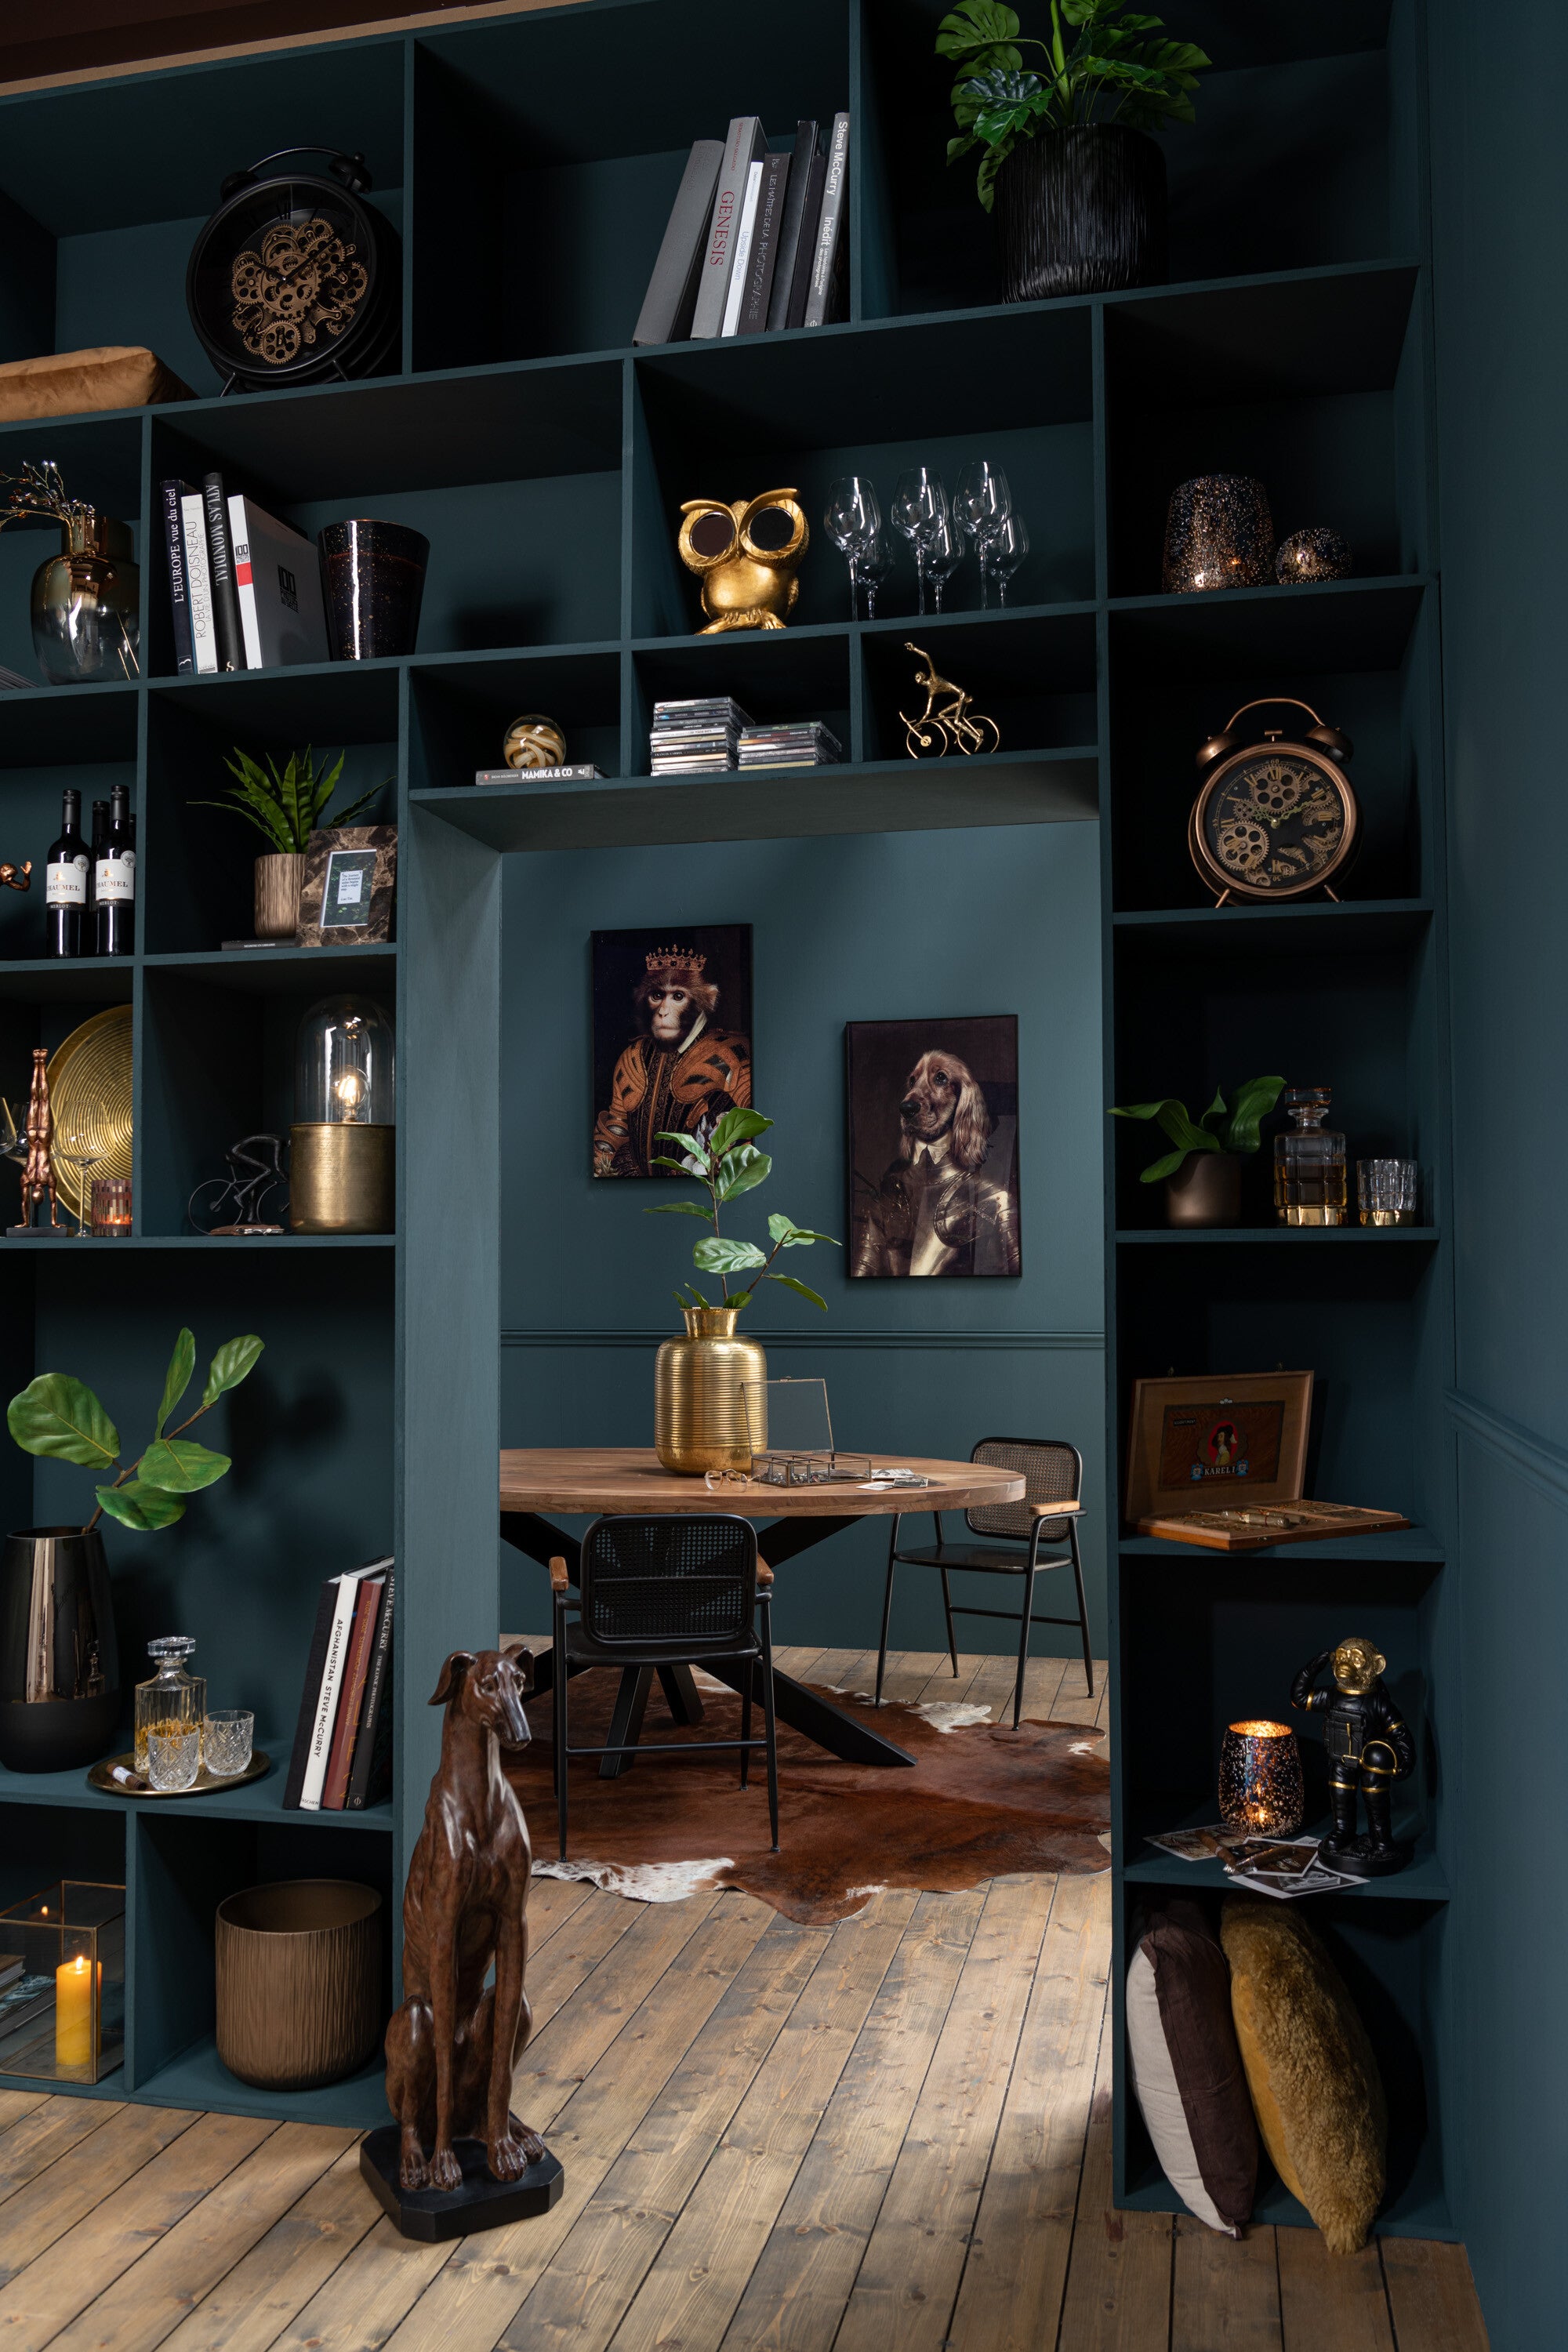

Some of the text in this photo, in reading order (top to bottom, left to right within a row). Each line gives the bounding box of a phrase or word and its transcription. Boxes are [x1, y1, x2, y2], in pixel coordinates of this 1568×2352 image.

[769, 175, 778, 187] LES
[826, 121, 848, 196] Steve McCurry
[710, 191, 735, 267] GENESIS
[763, 218, 771, 228] DE
[821, 216, 834, 246] Inédit
[734, 230, 750, 281] Upside Down
[747, 241, 768, 321] PHOTOGRAPHIE
[165, 488, 184, 603] L'EUROPE vue du ciel
[185, 521, 201, 589] DOISNEAU
[205, 485, 229, 586] ATLAS MONDIAL
[235, 544, 248, 556] 100
[278, 564, 296, 596] 100
[191, 593, 207, 639] ROBERT
[521, 770, 553, 780] MAMIKA
[554, 768, 561, 778] &
[561, 768, 573, 777] CO
[96, 880, 129, 888] HAUMEL
[1204, 1466, 1231, 1475] KAREL
[379, 1606, 394, 1651] McCURRY
[314, 1618, 343, 1759] AFGHANISTAN STEVE McCURRY
